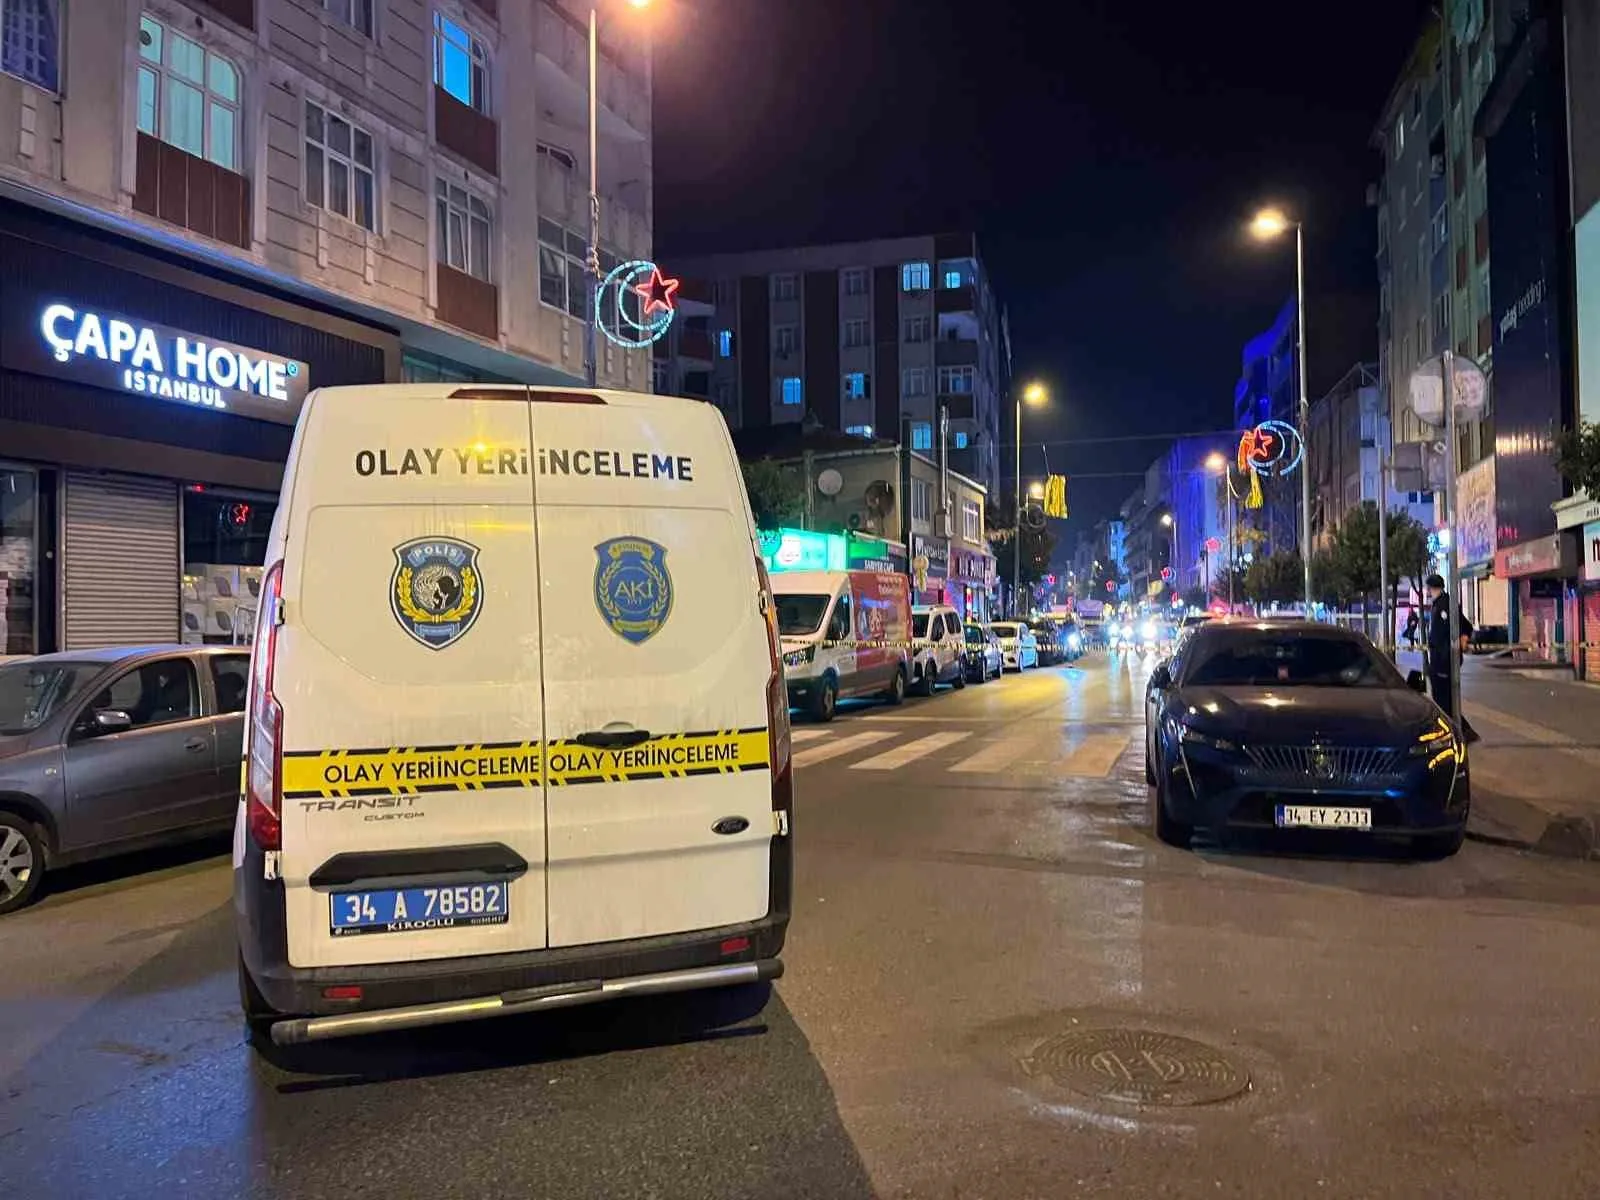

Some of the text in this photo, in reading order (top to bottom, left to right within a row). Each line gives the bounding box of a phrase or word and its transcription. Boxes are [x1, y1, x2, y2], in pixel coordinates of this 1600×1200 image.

[41, 304, 288, 400] ÇAPA HOME
[355, 449, 443, 476] OLAY
[550, 753, 604, 772] OLAY
[324, 763, 384, 784] OLAY
[299, 795, 421, 813] TRANSIT
[364, 812, 425, 822] CUSTOM
[1286, 807, 1301, 823] 34
[345, 885, 500, 924] 34 A 78582
